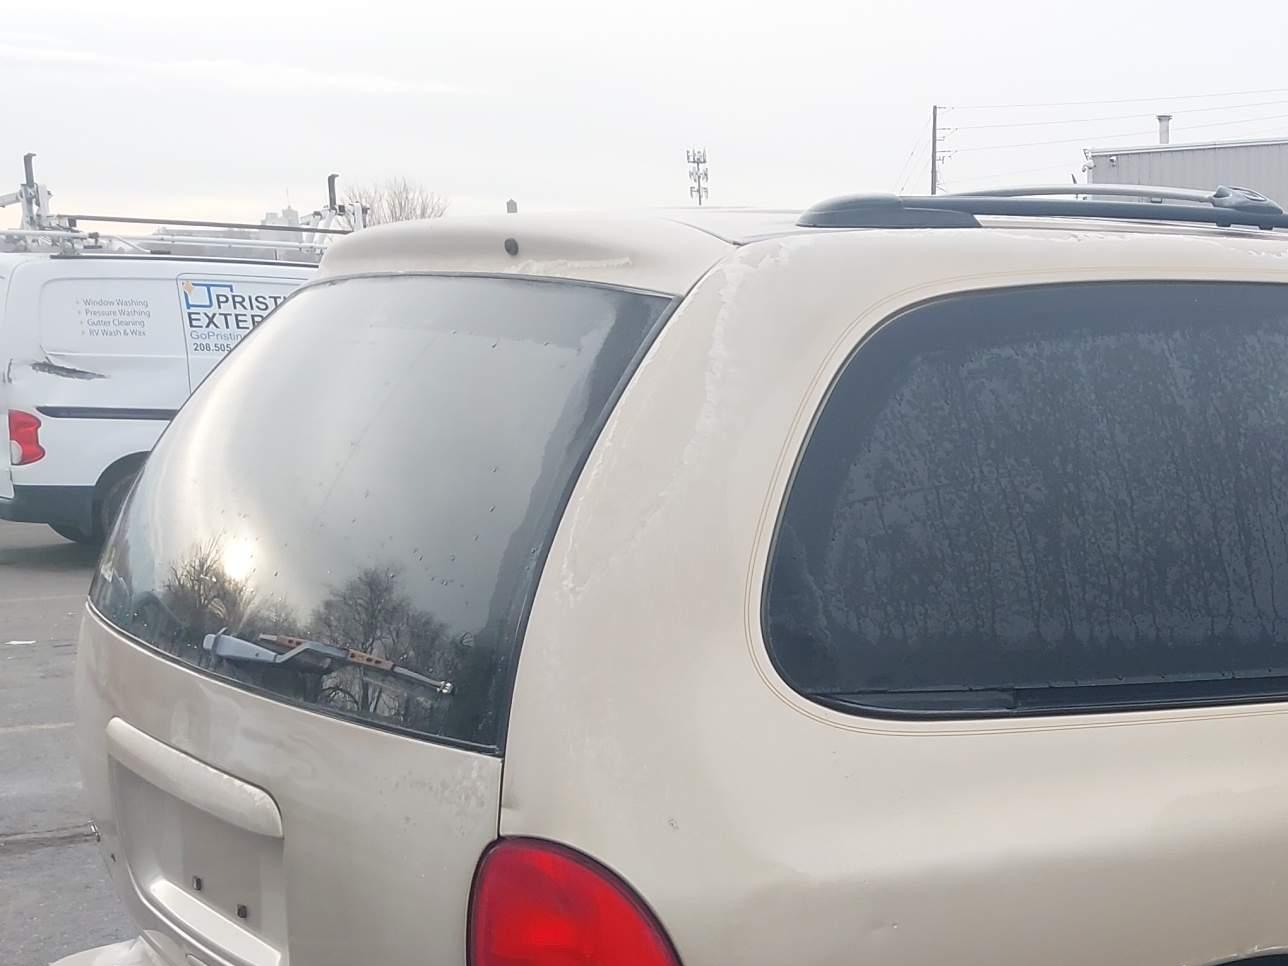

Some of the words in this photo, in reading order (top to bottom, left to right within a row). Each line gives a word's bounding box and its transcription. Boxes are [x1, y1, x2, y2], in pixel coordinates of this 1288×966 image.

[82, 298, 115, 306] Window
[115, 298, 149, 308] Washing
[216, 293, 288, 311] PRIST
[85, 308, 117, 317] Pressure
[117, 309, 151, 318] Washing
